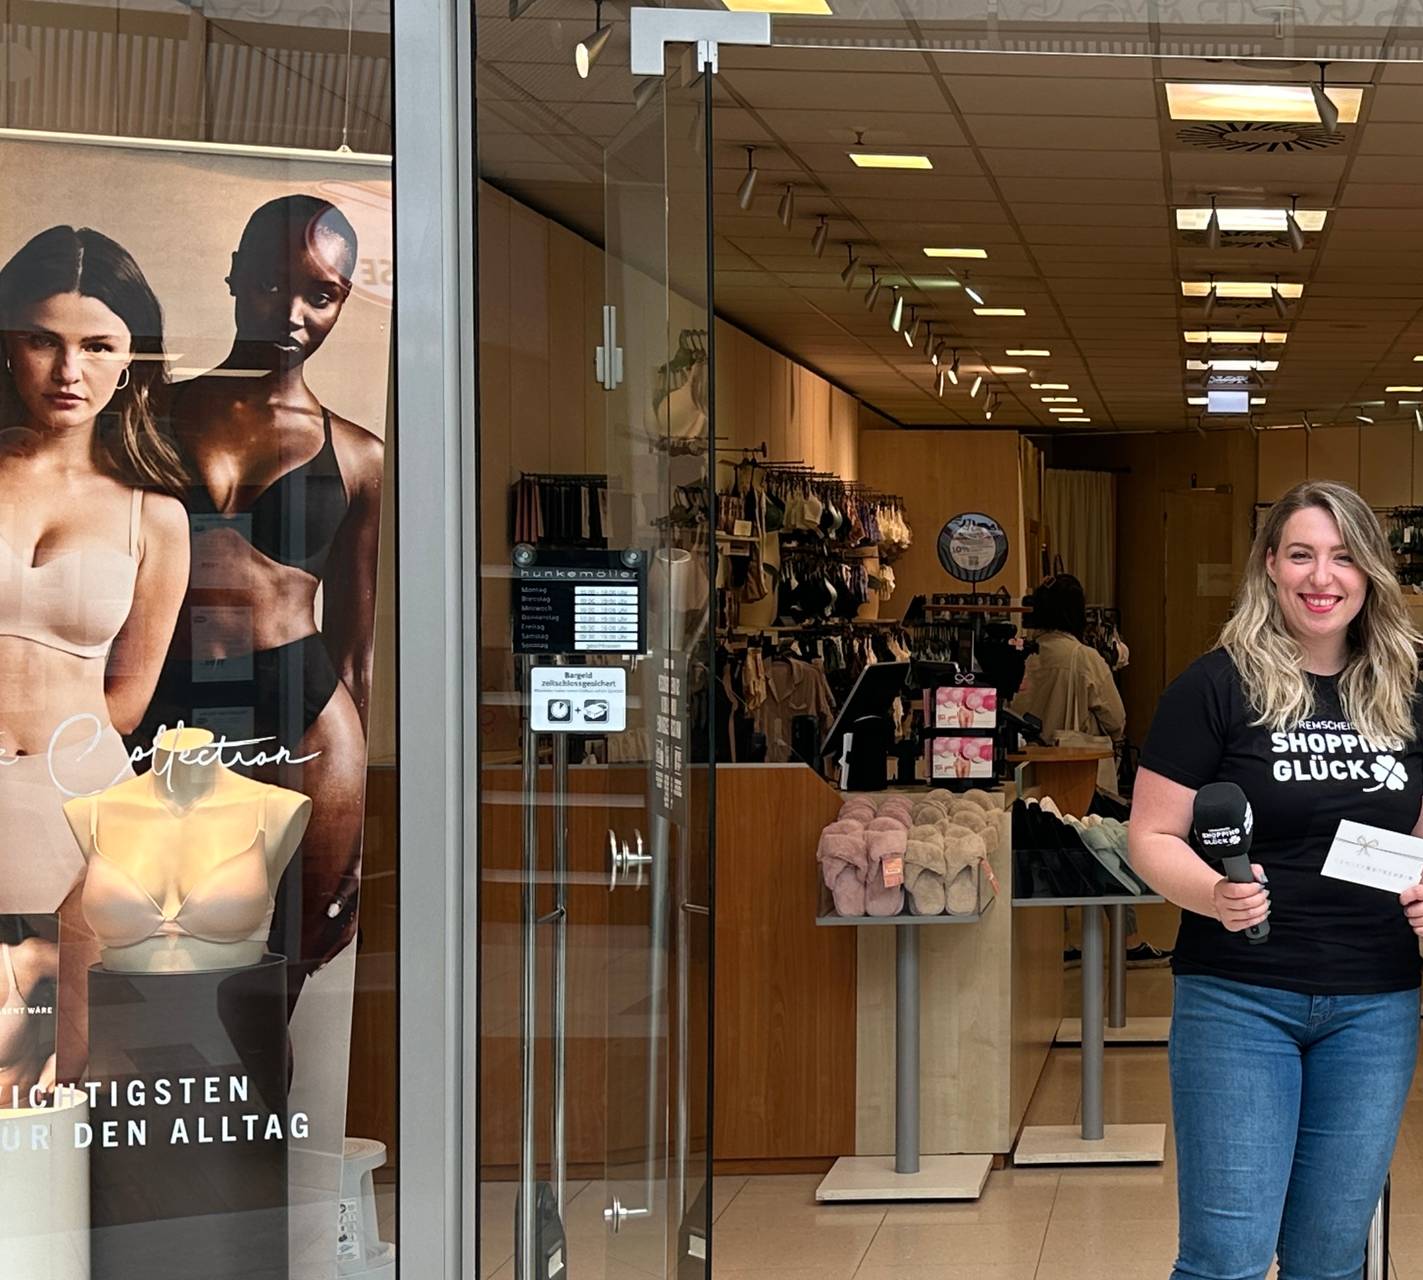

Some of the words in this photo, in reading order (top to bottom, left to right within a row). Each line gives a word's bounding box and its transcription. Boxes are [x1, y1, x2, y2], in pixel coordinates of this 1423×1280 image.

[564, 671, 593, 680] Bargeld
[1298, 720, 1357, 731] REMSCHEI
[1273, 754, 1370, 782] GLÜCK
[0, 1075, 249, 1110] ICHTIGSTEN
[1, 1121, 49, 1152] ÜR
[74, 1119, 147, 1149] DEN
[170, 1112, 310, 1145] ALLTAG
